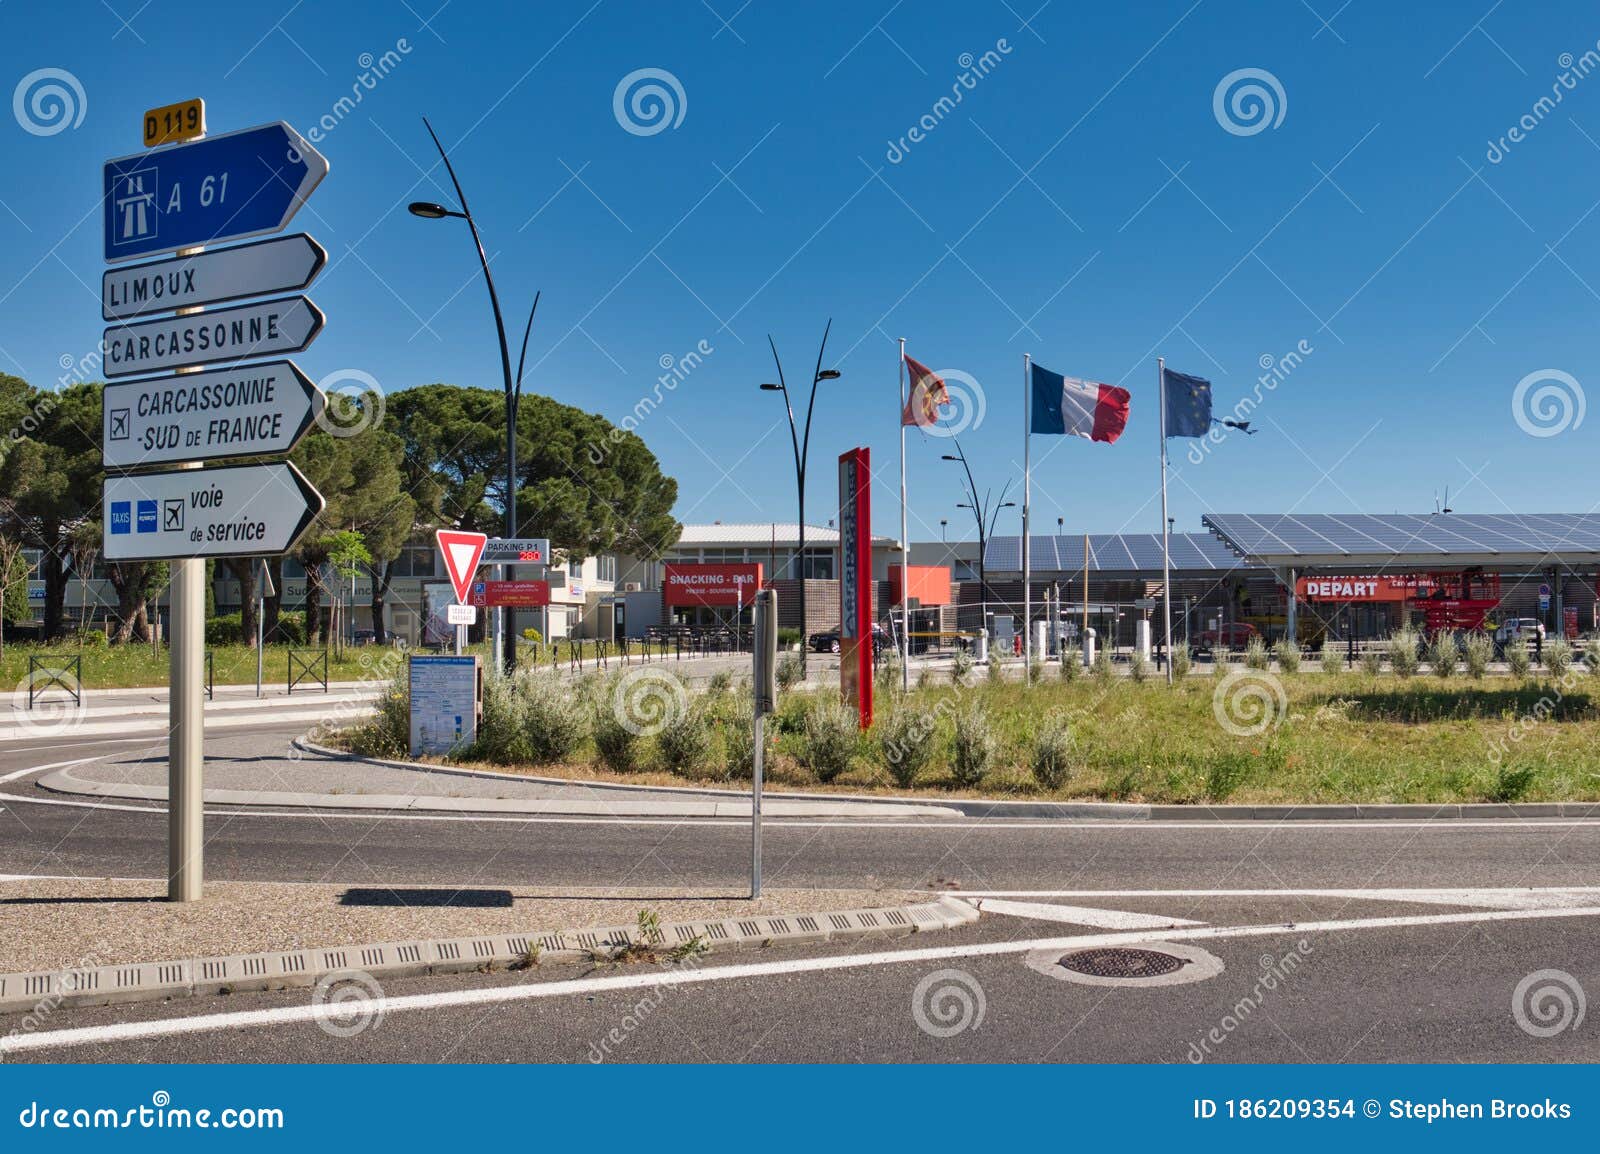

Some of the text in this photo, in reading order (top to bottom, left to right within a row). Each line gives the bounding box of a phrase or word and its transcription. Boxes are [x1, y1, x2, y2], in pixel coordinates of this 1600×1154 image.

[146, 106, 198, 140] D 119
[166, 172, 228, 214] A 61
[110, 268, 195, 307] LIMOUX
[111, 314, 279, 363] CARCASSONNE
[137, 377, 276, 417] CARCASSONNE
[185, 430, 201, 447] DE
[207, 413, 283, 445] FRANCE
[190, 483, 224, 509] voie
[112, 511, 130, 524] TAXIS
[190, 516, 266, 542] de service
[487, 543, 524, 552] PARKING
[519, 551, 541, 561] 280
[669, 575, 724, 584] SNACKING
[732, 574, 754, 584] BAR
[1307, 582, 1378, 597] DEPART
